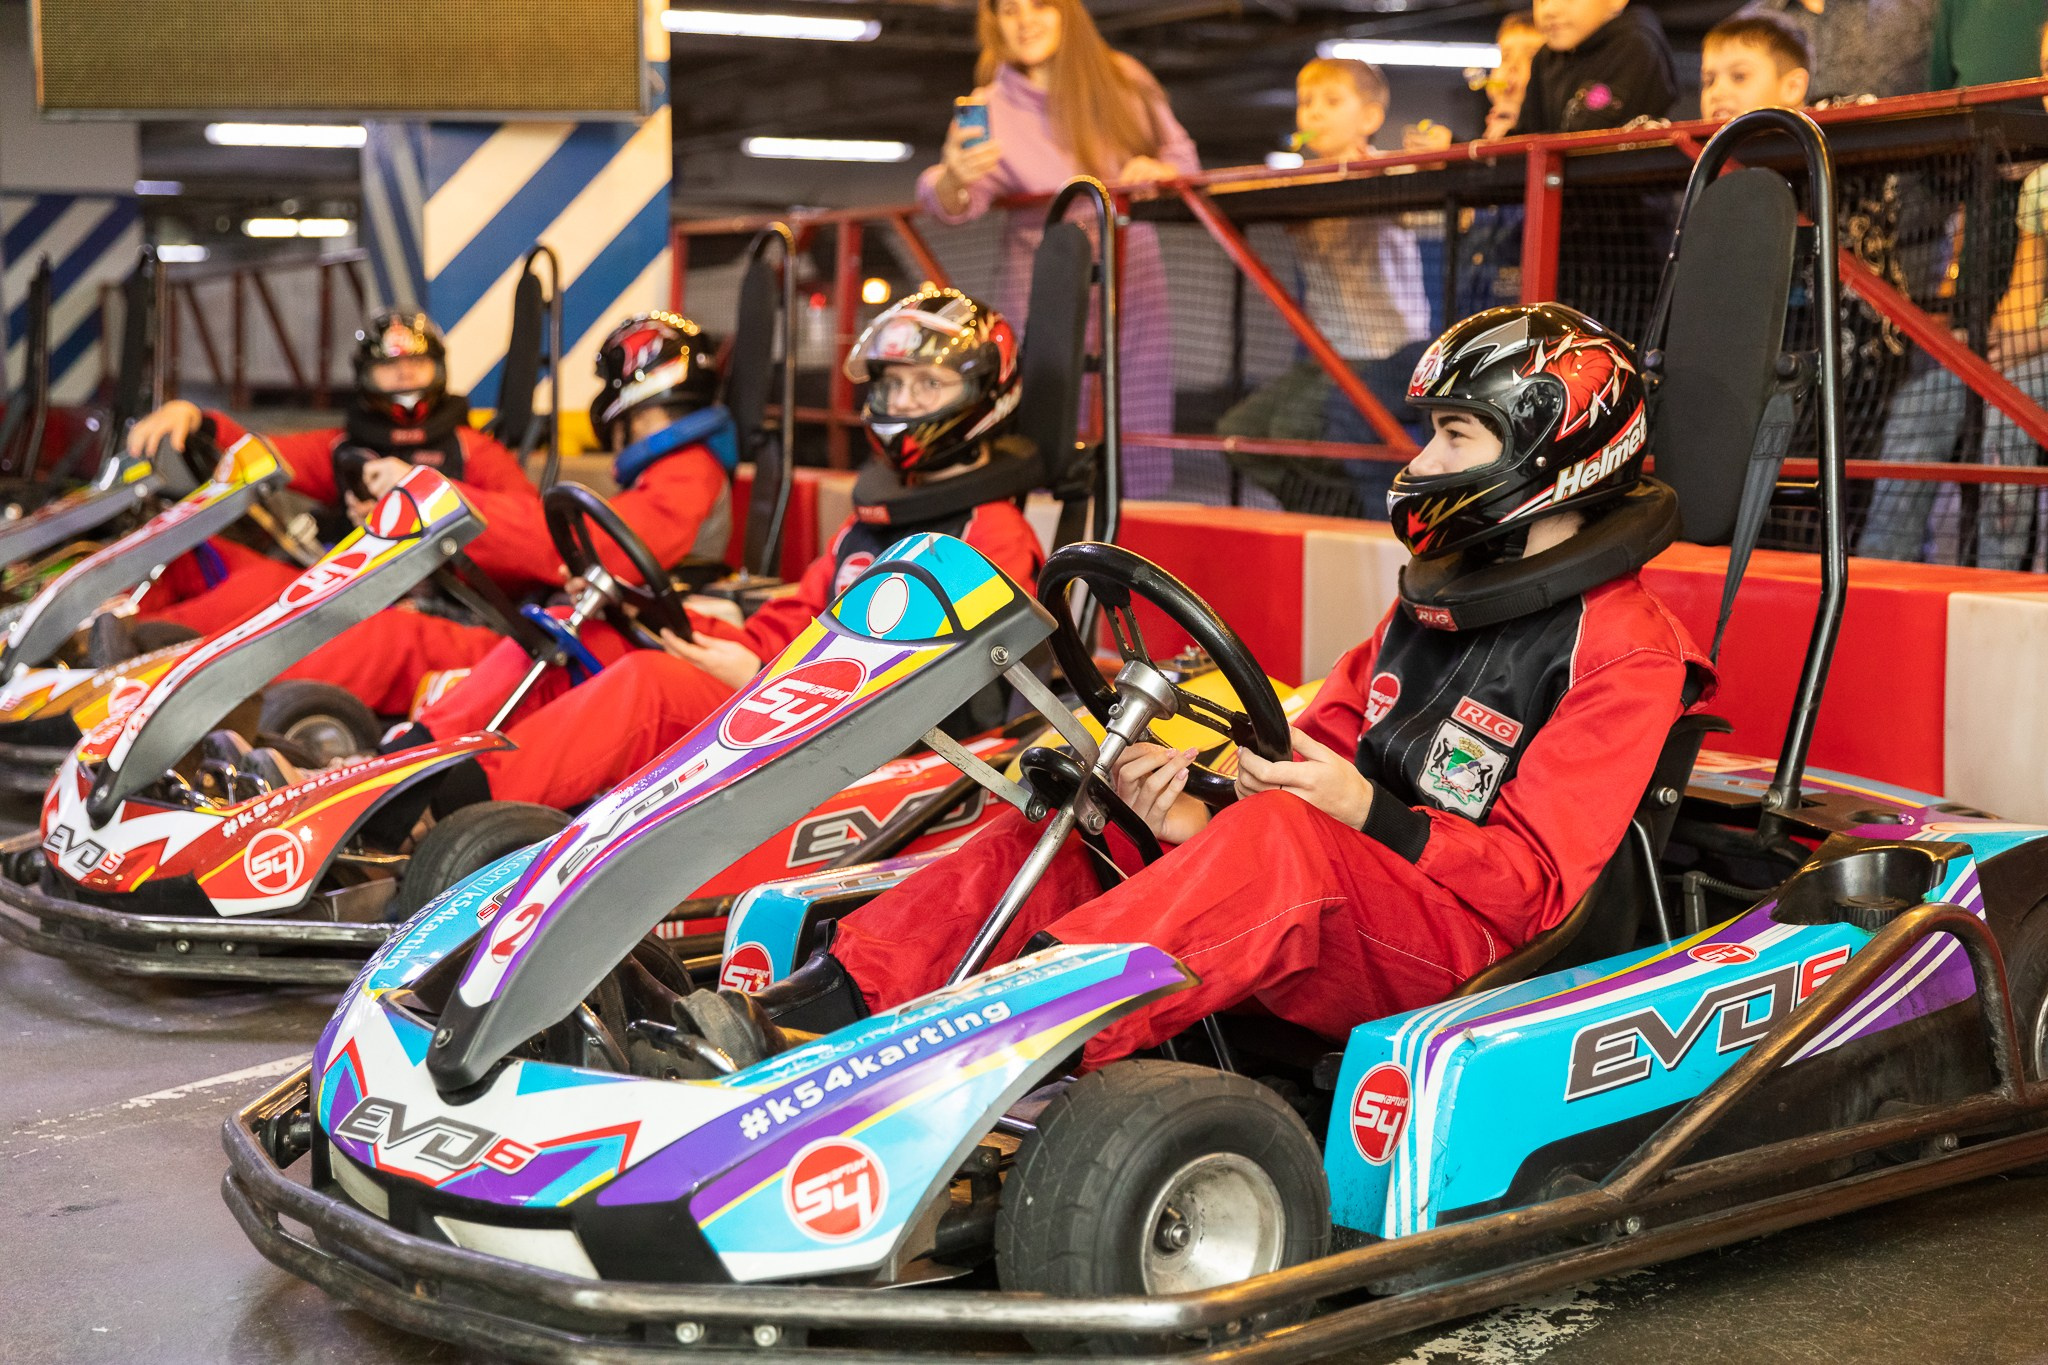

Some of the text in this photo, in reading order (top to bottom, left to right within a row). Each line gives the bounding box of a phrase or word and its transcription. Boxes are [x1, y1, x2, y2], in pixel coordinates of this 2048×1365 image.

[1552, 410, 1647, 504] Helmet
[1460, 704, 1515, 740] RLG
[491, 903, 546, 956] 2
[738, 1000, 1012, 1142] #k54karting
[334, 1096, 543, 1175] EVO6
[794, 1172, 873, 1230] 54
